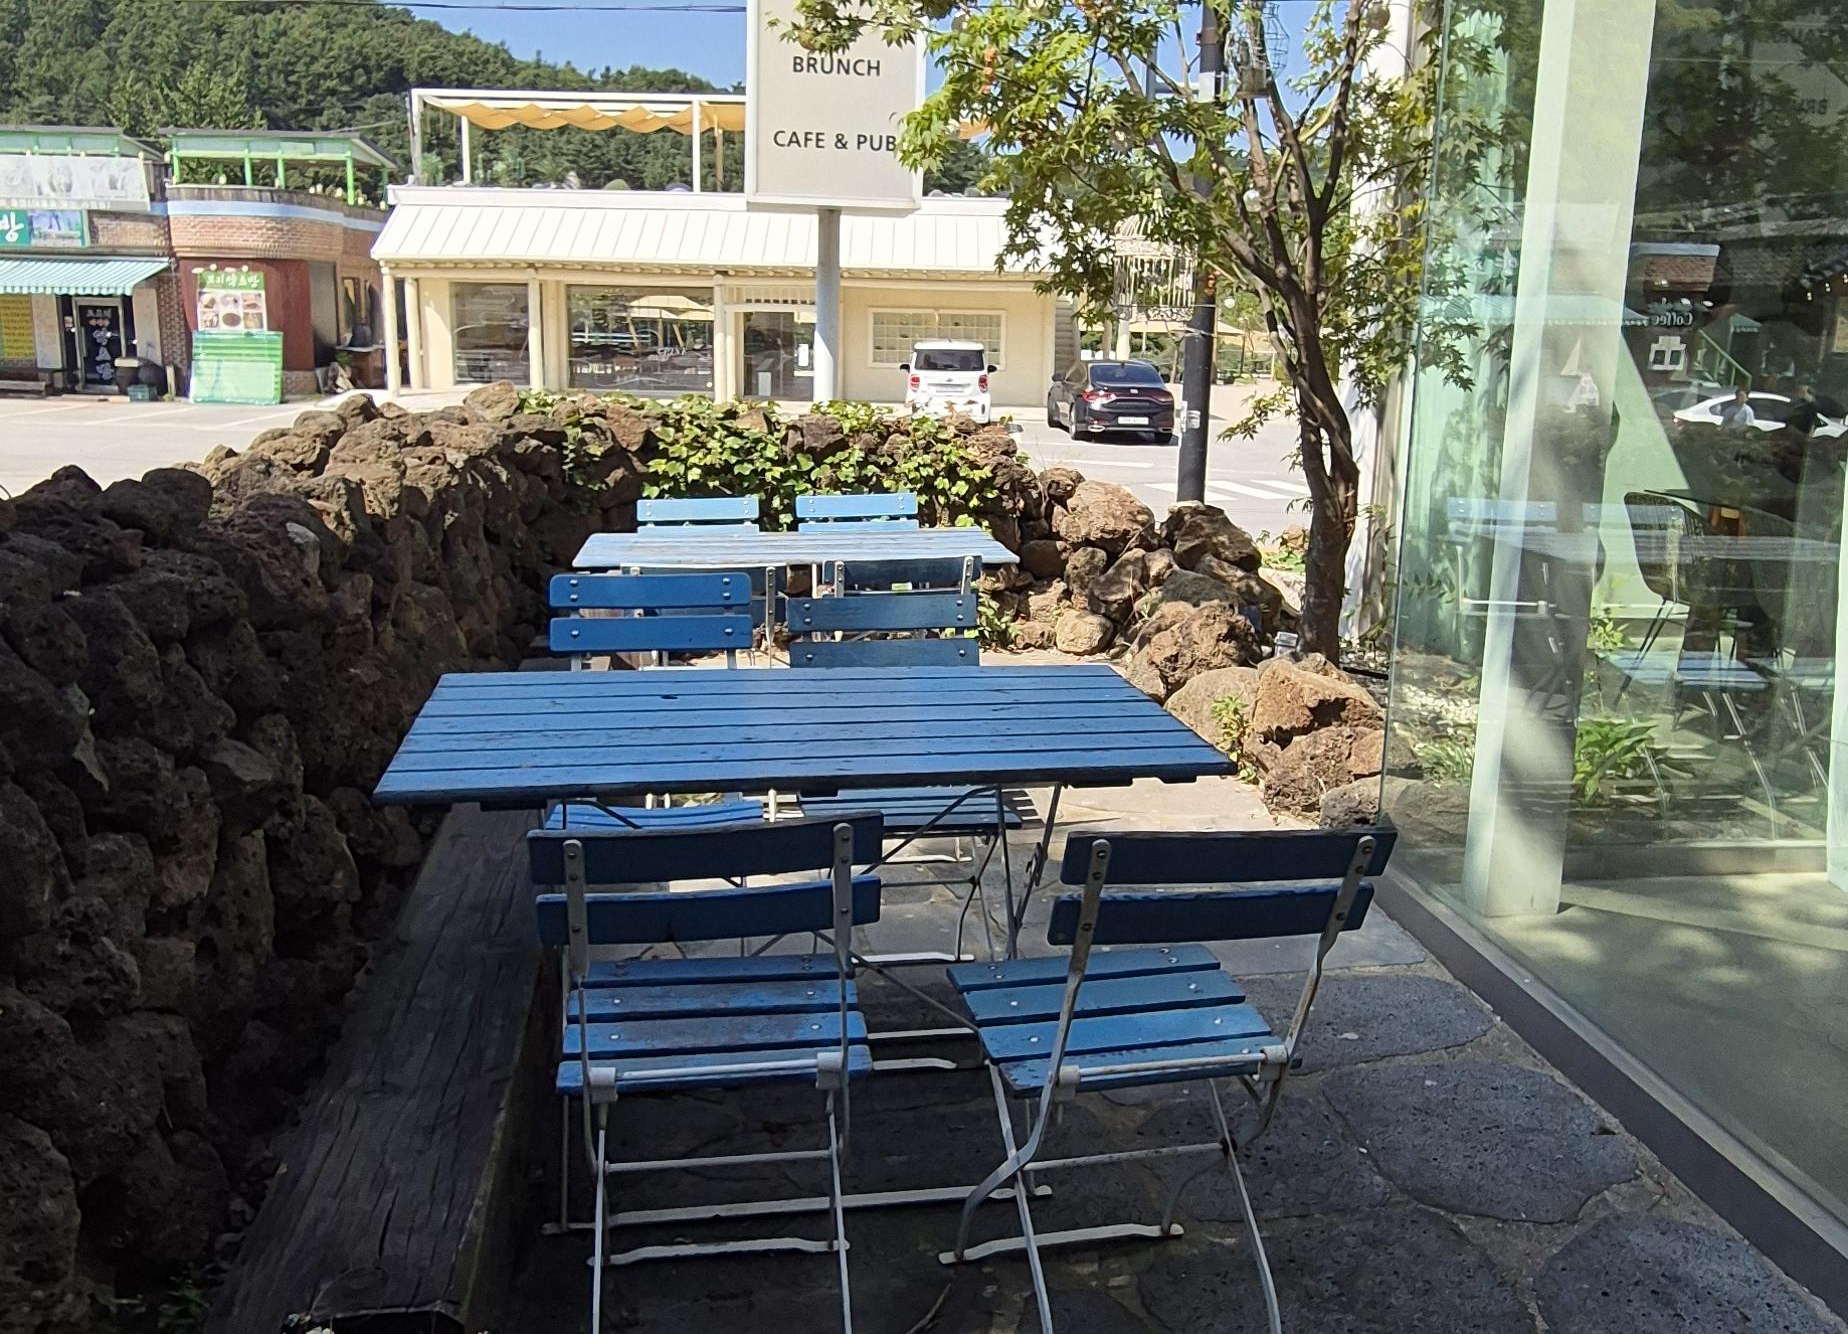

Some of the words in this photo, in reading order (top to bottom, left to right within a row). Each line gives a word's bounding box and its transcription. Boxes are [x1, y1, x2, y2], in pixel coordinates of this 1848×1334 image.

[792, 55, 881, 77] BRUNCH
[773, 130, 826, 149] CAFE
[834, 132, 849, 150] &
[856, 133, 897, 152] PUB
